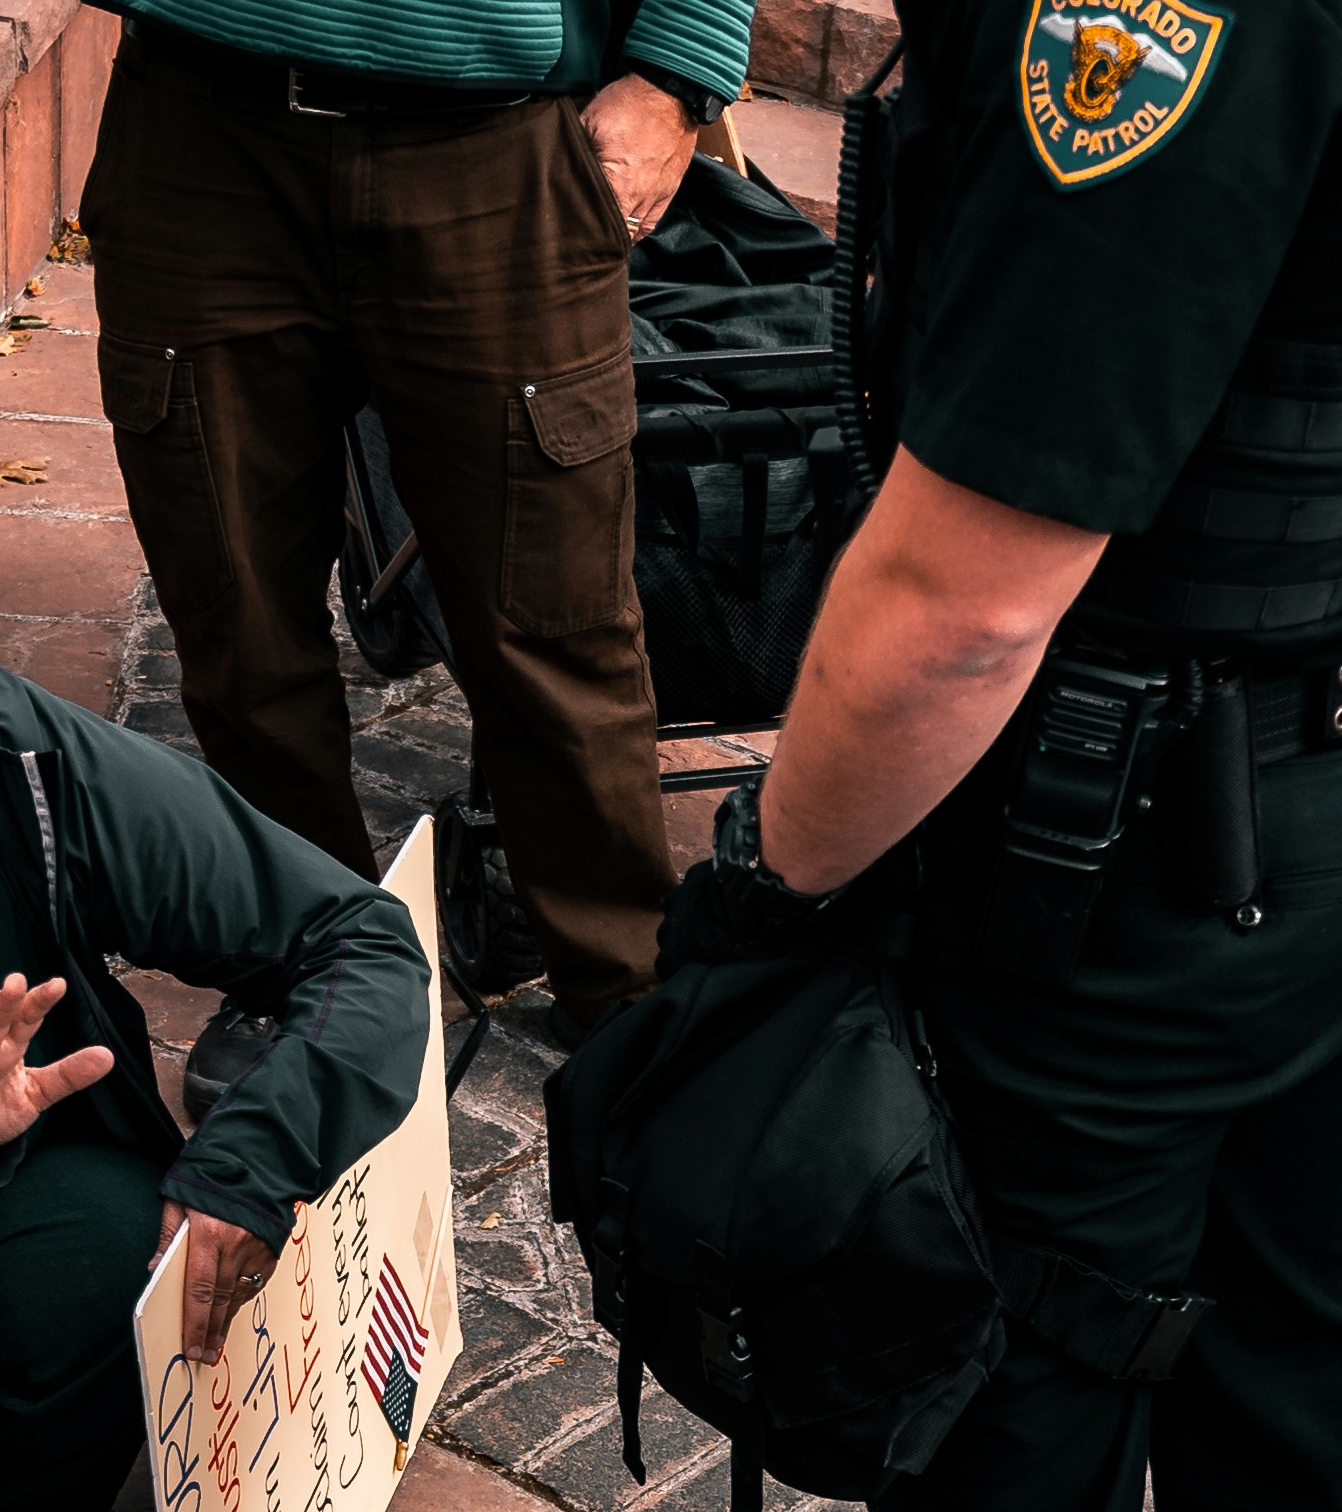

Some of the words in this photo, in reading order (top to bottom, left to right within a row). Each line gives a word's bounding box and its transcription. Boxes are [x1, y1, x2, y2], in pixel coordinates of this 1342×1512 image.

[1028, 60, 1067, 143] STATE
[1070, 100, 1170, 157] PATROL
[1059, 690, 1113, 709] MOTOROLA
[330, 1178, 352, 1327] every
[348, 1163, 373, 1319] ballot
[241, 1289, 279, 1474] Libe
[335, 1332, 364, 1490] Count
